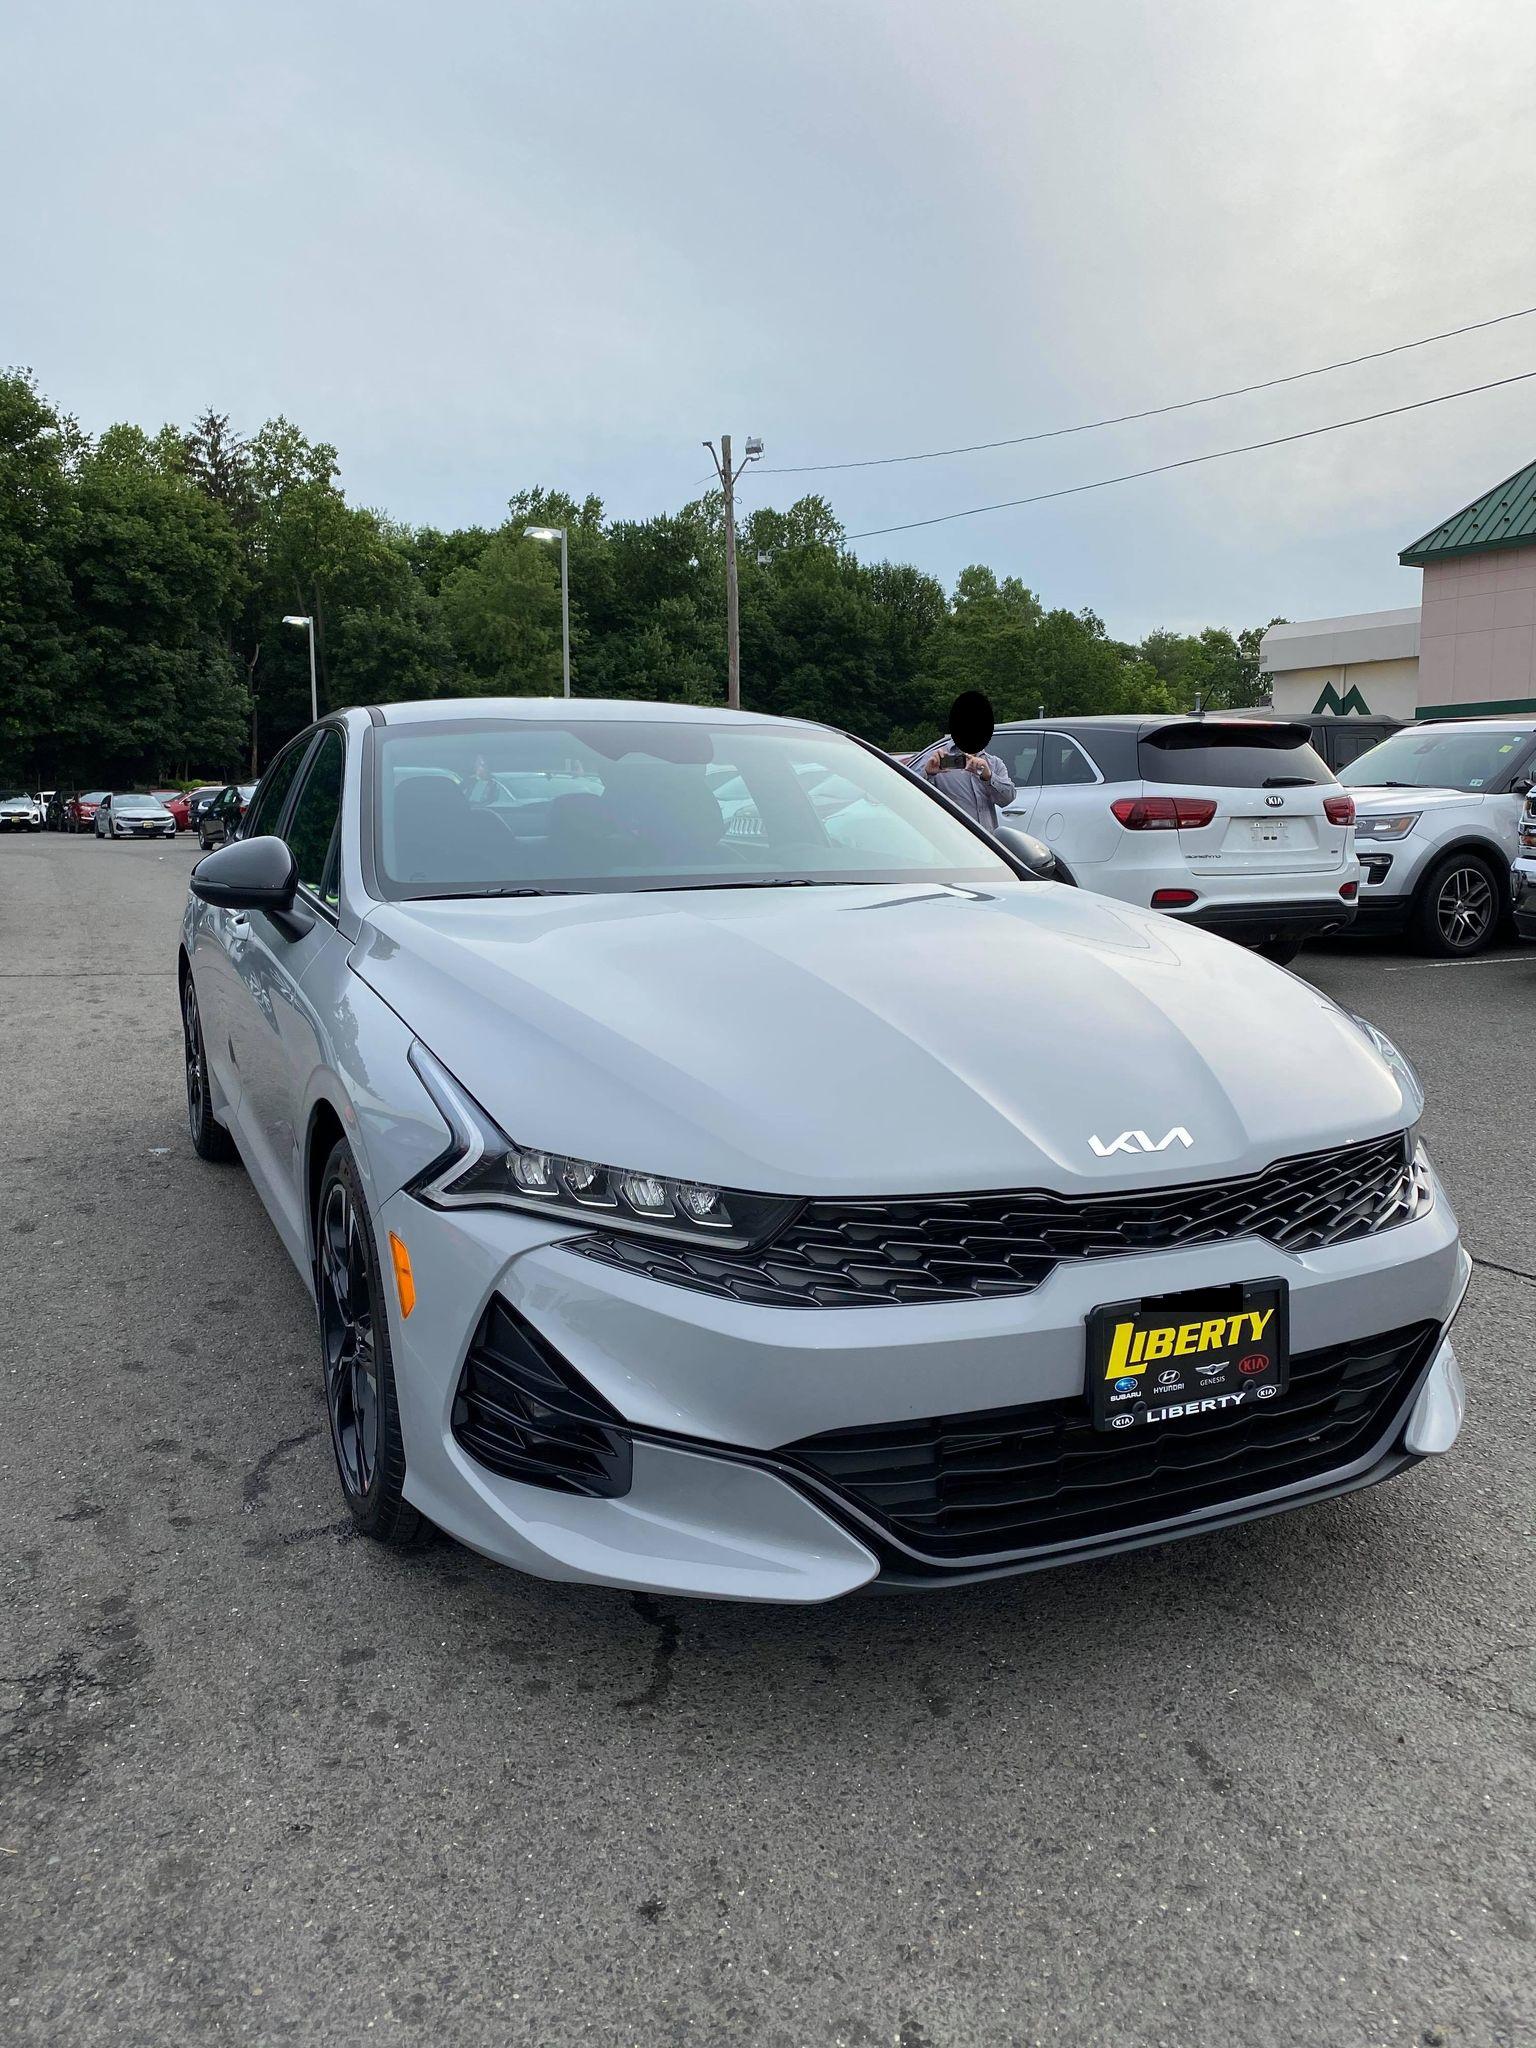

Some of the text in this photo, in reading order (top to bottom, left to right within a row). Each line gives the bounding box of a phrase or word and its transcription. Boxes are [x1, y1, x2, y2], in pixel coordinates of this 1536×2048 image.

[1105, 1309, 1274, 1380] LIBERTY
[1242, 1356, 1266, 1373] KIA
[1200, 1375, 1226, 1387] GENESIS
[1153, 1383, 1185, 1394] HYUNDAI
[1259, 1388, 1274, 1398] KIA
[1110, 1391, 1142, 1402] SUBARU
[1146, 1392, 1246, 1423] LIBERTY
[1114, 1417, 1131, 1427] KIA
